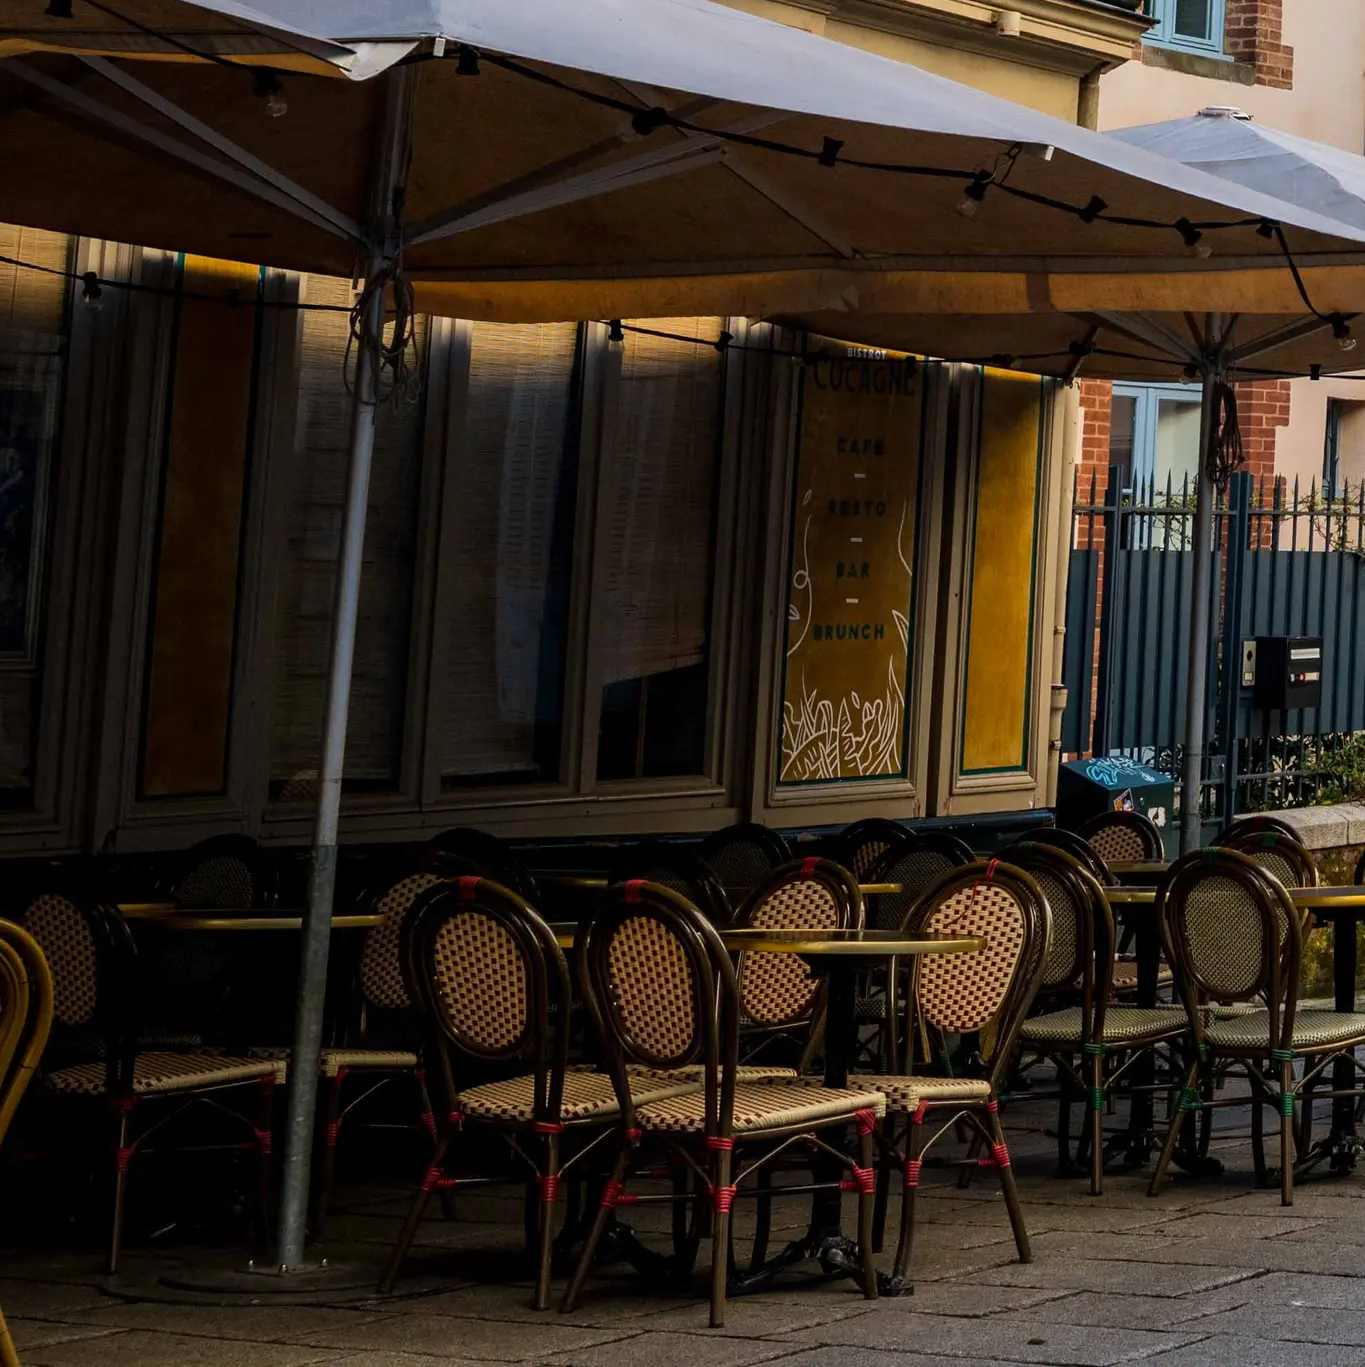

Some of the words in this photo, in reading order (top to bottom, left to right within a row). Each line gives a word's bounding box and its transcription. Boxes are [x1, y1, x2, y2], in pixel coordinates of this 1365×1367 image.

[847, 347, 887, 360] BISTROT
[813, 360, 917, 395] COCAGNE
[829, 499, 887, 517] RESTO
[835, 562, 870, 579] BAR
[813, 623, 885, 640] BRUNCH
